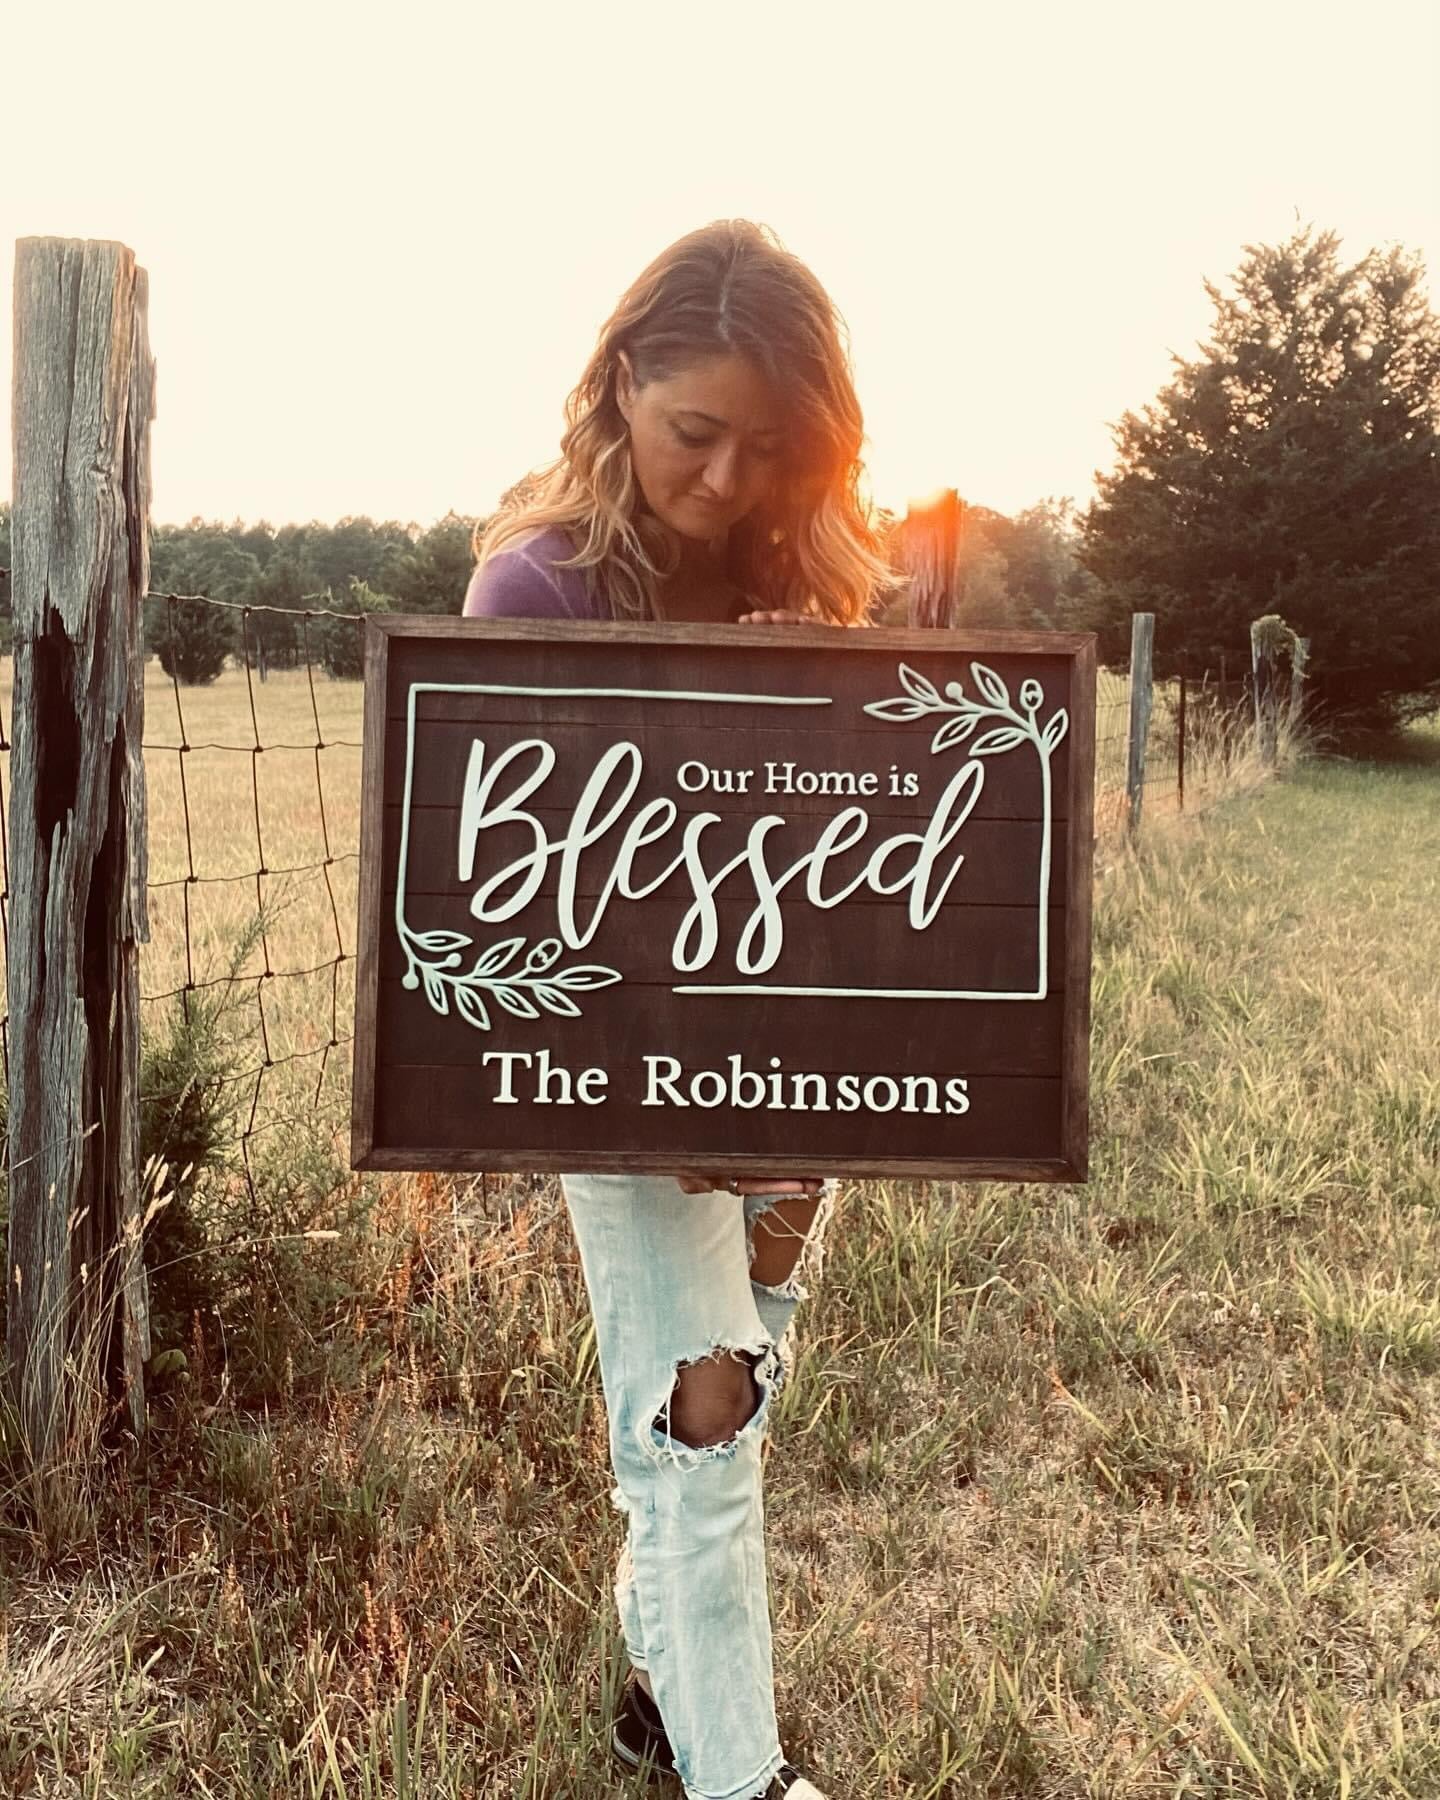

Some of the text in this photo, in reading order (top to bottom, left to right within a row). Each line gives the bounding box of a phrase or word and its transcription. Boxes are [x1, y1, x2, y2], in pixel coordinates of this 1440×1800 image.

[676, 760, 921, 797] Our Home is
[457, 737, 986, 976] Blessed
[481, 1049, 972, 1115] The Robinsons
